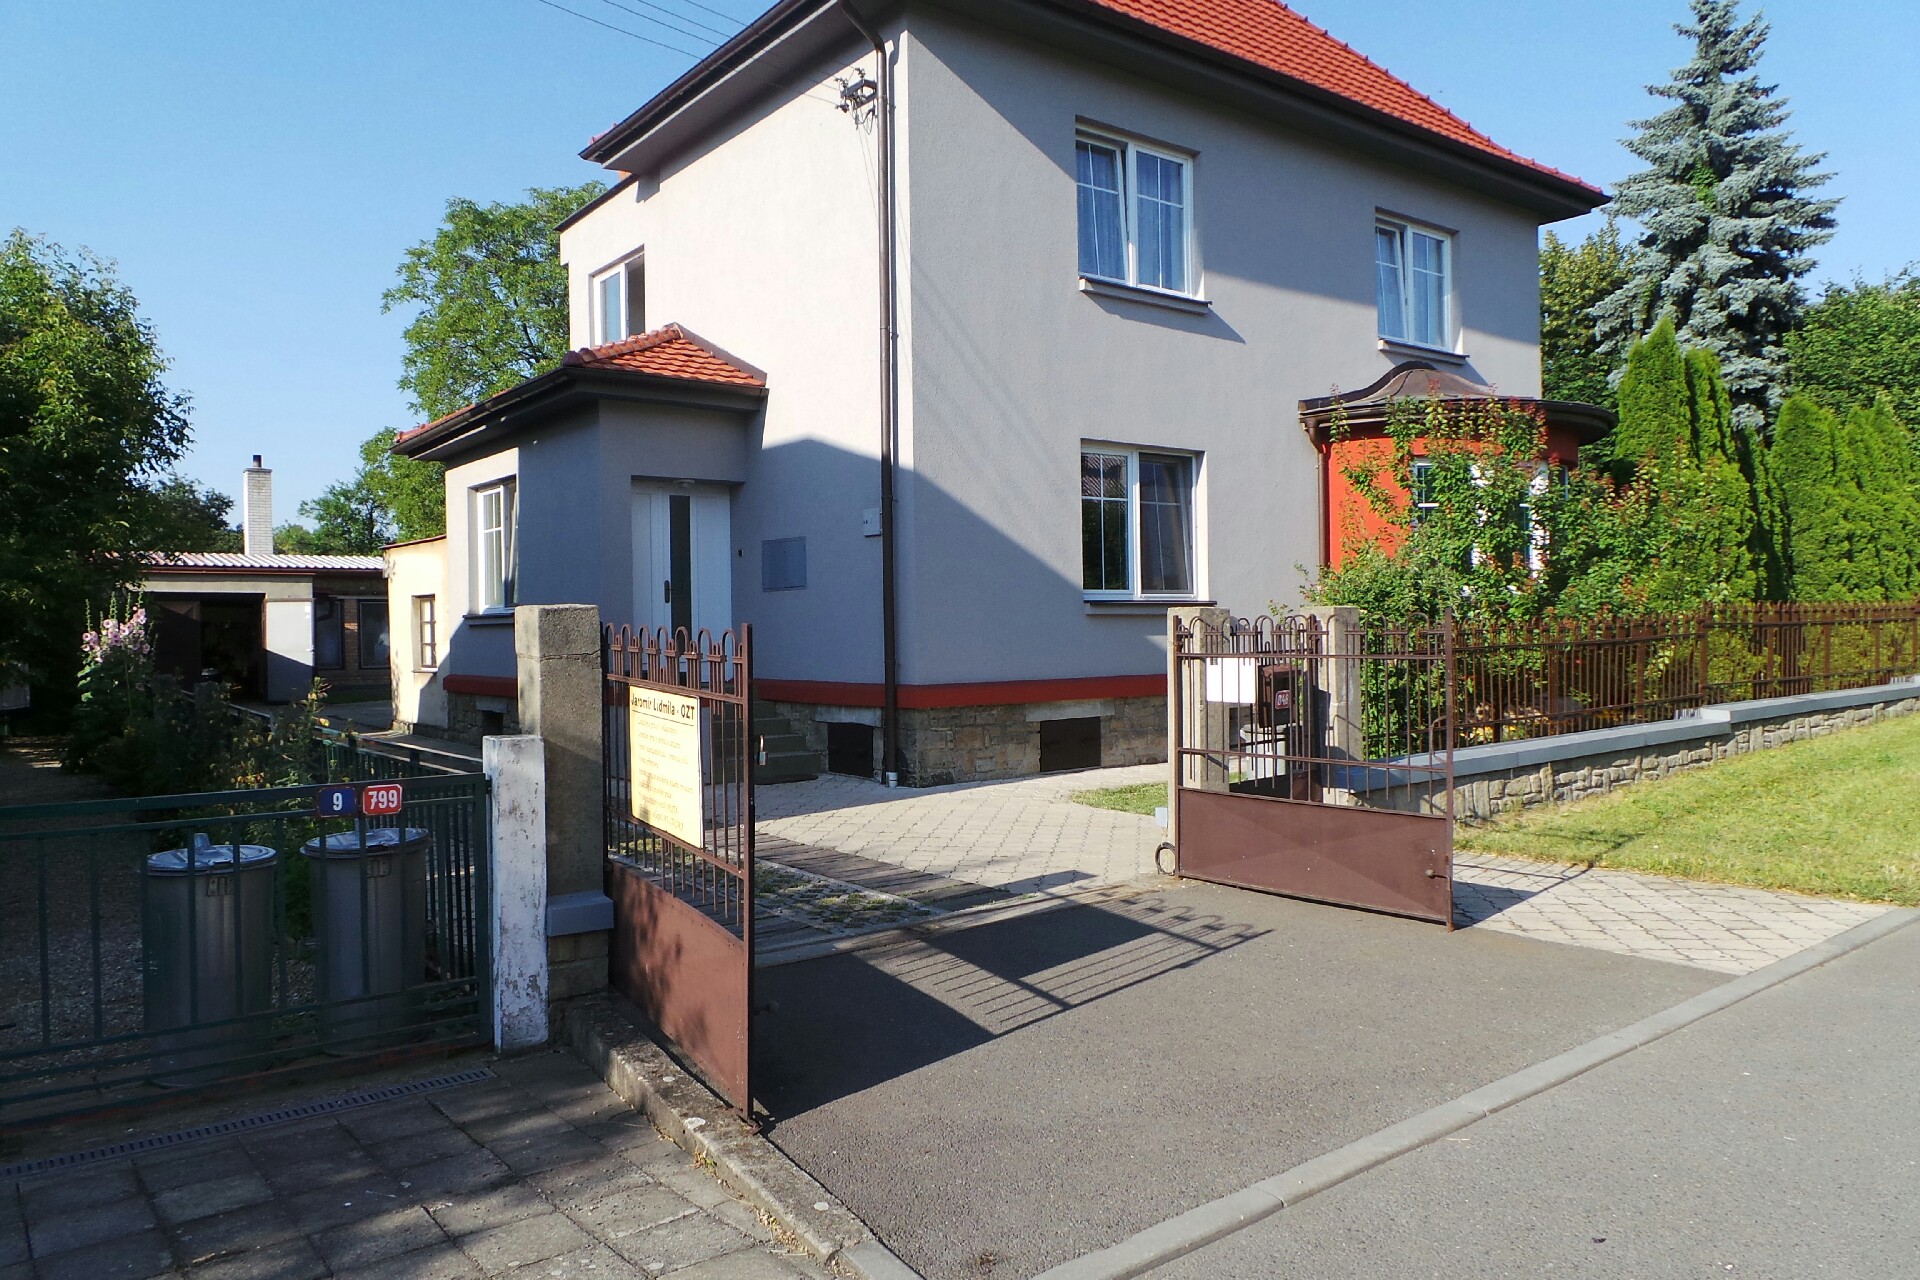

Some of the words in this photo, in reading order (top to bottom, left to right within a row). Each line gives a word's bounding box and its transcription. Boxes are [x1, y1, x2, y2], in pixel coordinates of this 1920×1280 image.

[681, 704, 695, 719] OZT
[333, 792, 343, 811] 9
[368, 790, 398, 809] 799
